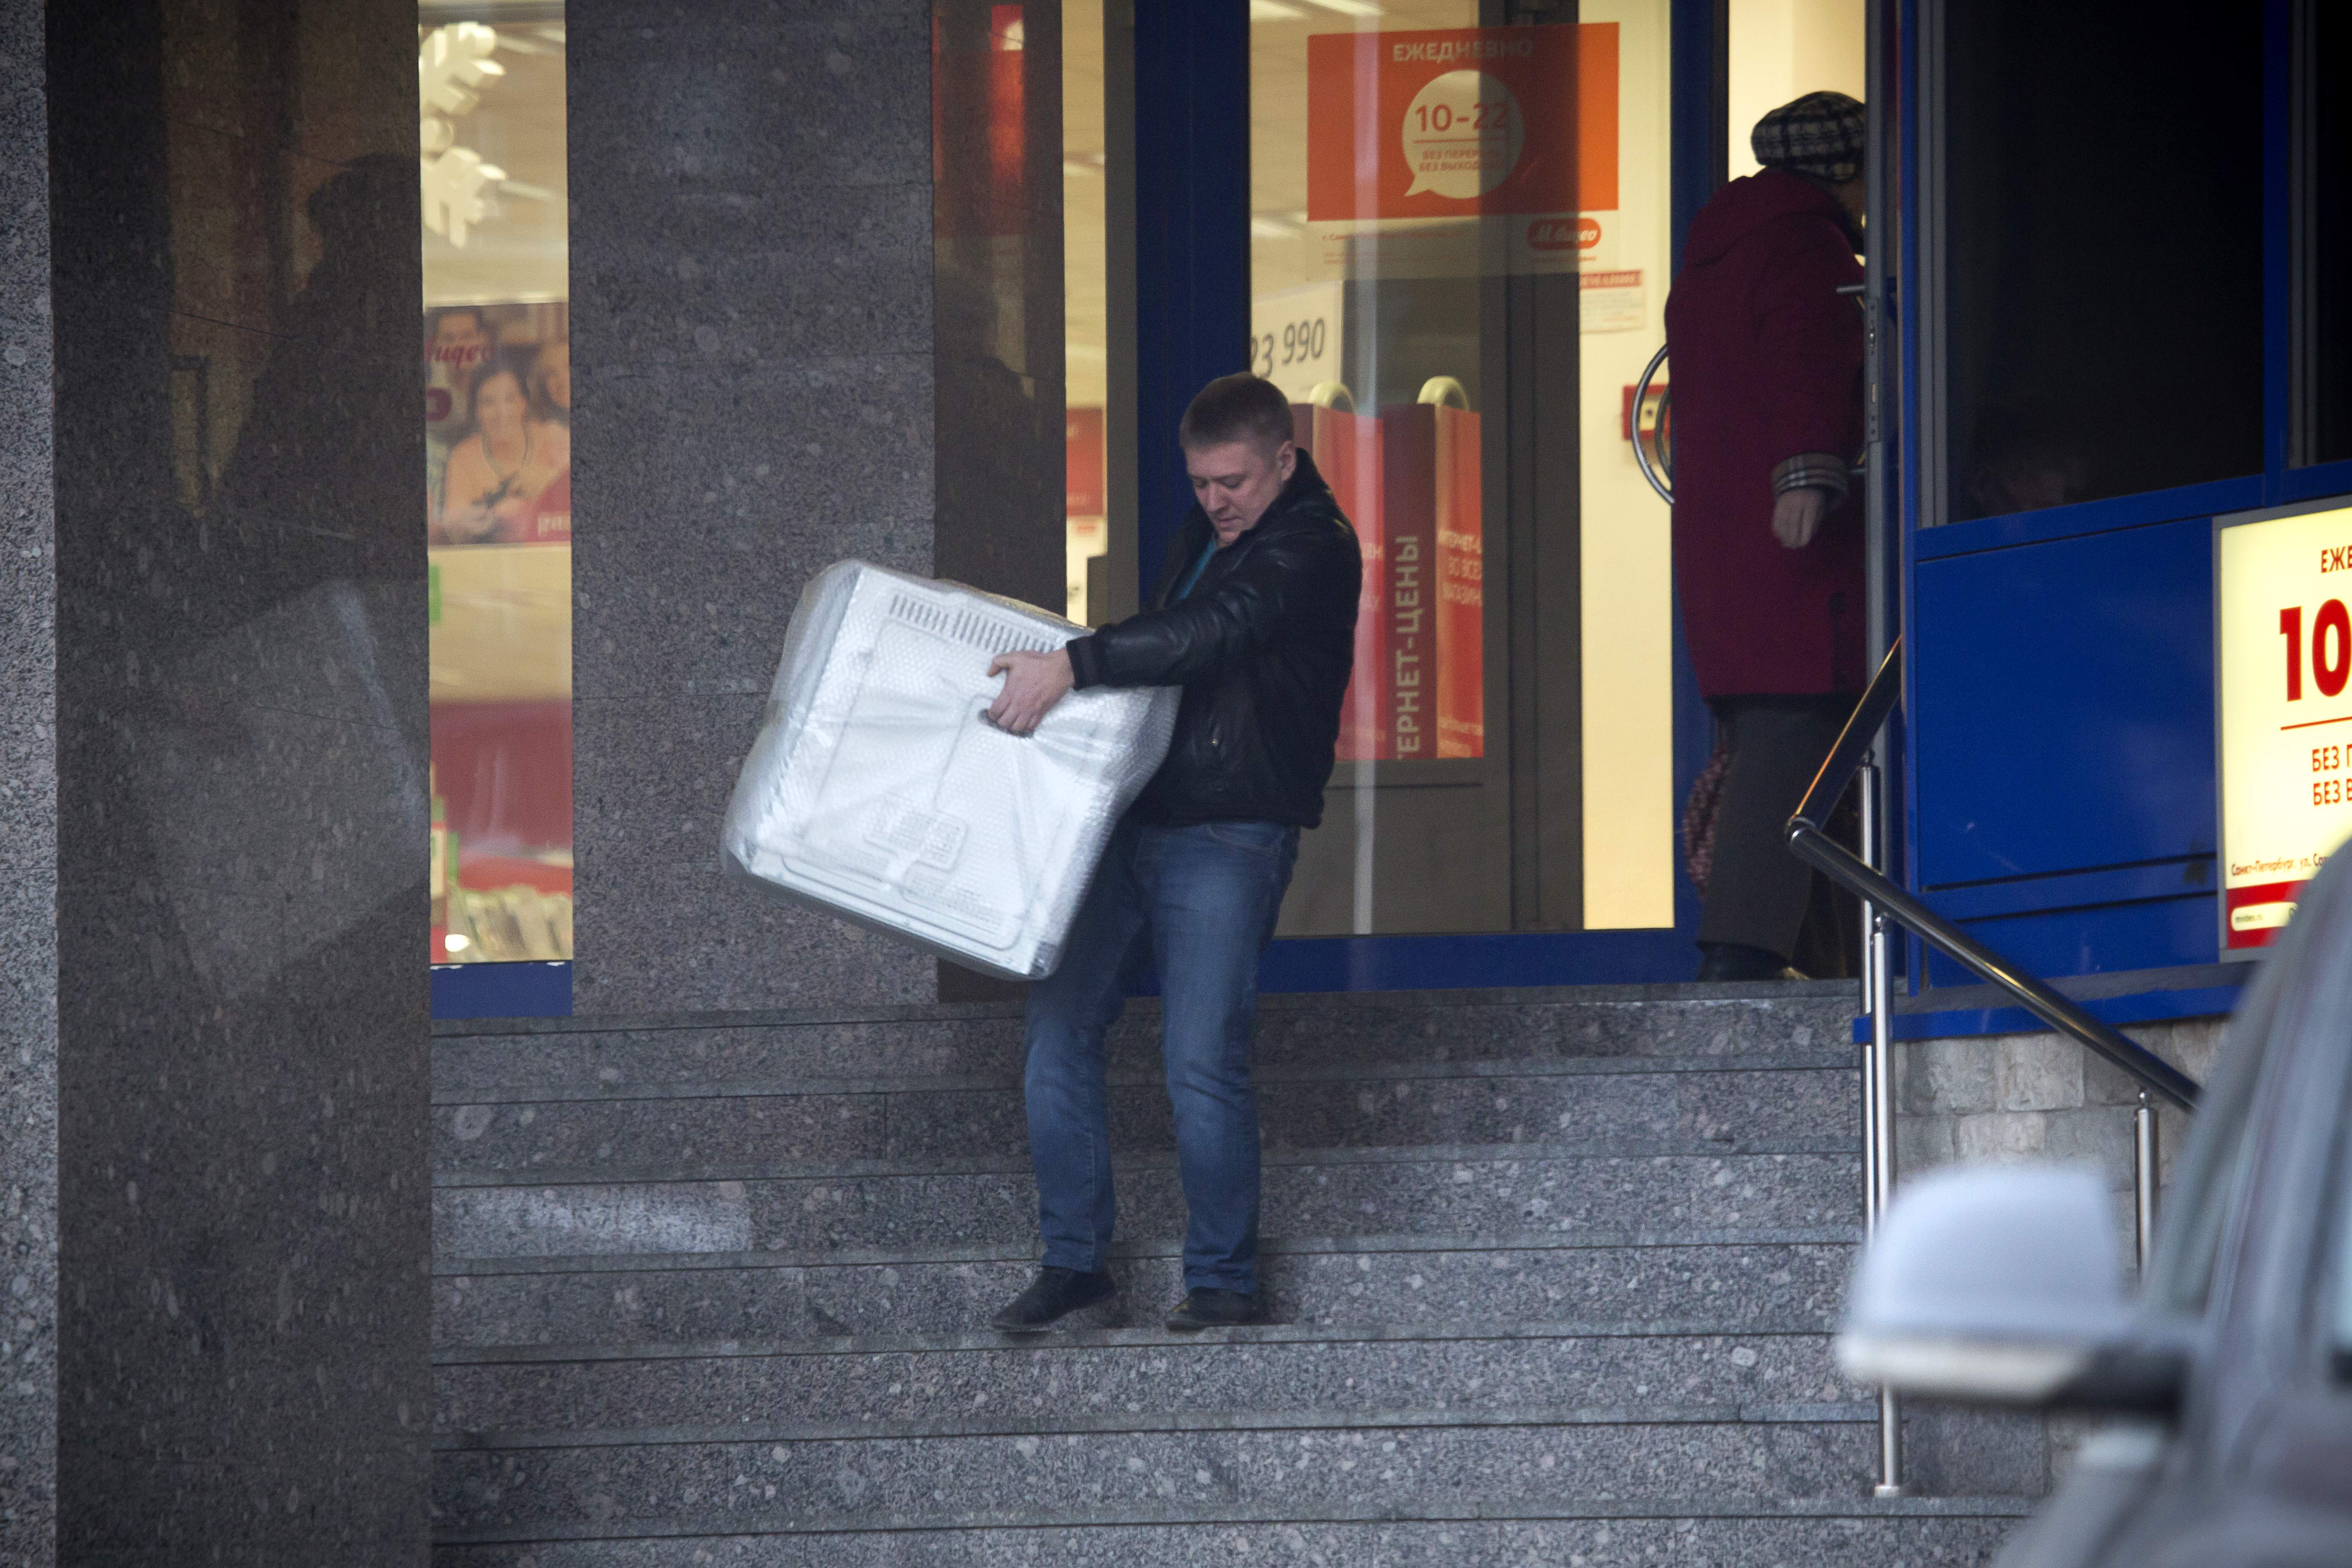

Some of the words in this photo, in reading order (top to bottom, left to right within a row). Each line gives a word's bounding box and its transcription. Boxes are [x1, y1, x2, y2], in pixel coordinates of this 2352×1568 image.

[1393, 39, 1533, 63] ЕЖЕДНЕВНО
[1281, 317, 1325, 365] 990
[2279, 599, 2352, 702] 10
[2312, 746, 2340, 772] БЕЗ
[2313, 780, 2341, 806] БЕЗ
